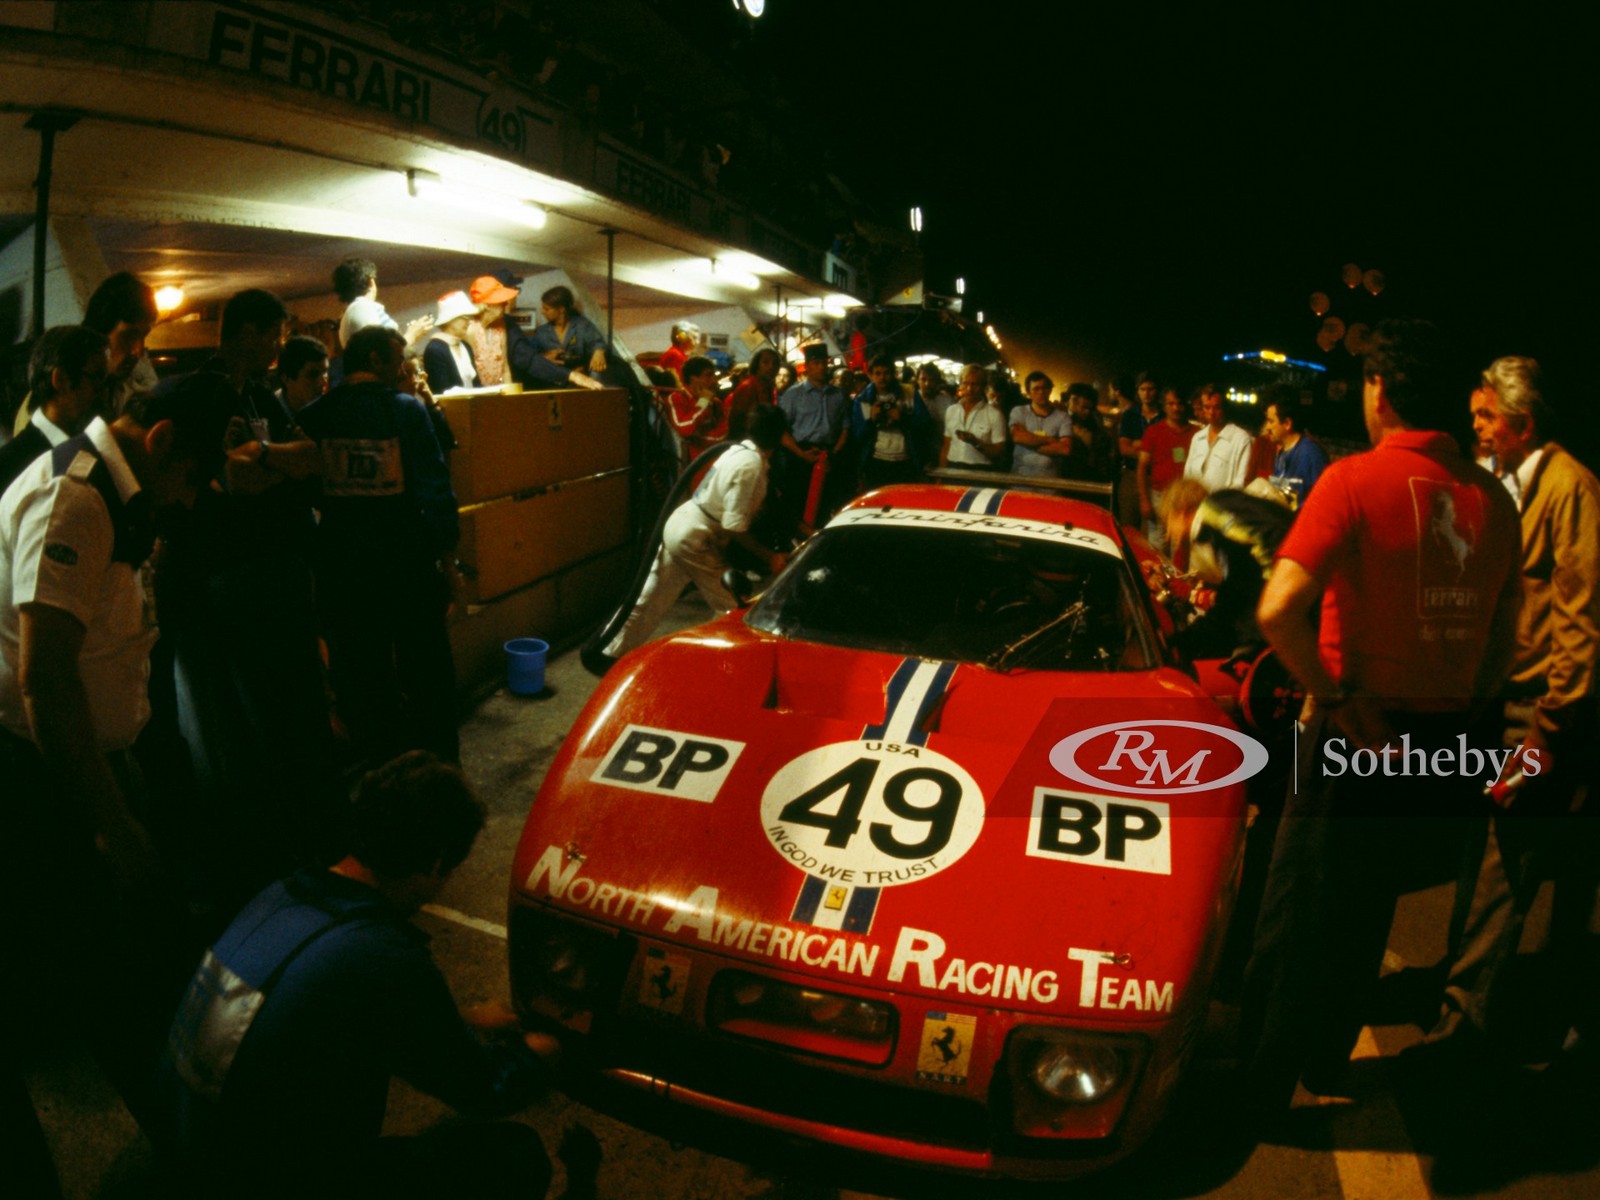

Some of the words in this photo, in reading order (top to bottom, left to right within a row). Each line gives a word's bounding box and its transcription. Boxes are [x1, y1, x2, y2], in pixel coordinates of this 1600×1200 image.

[208, 10, 432, 122] FERRARI
[482, 106, 524, 152] 49
[600, 730, 730, 790] BP
[865, 742, 921, 759] USA
[778, 757, 963, 860] 49
[1037, 794, 1162, 862] BP
[768, 825, 788, 843] IN
[781, 838, 818, 869] GOD
[819, 863, 856, 883] WE
[863, 857, 939, 884] TRUST
